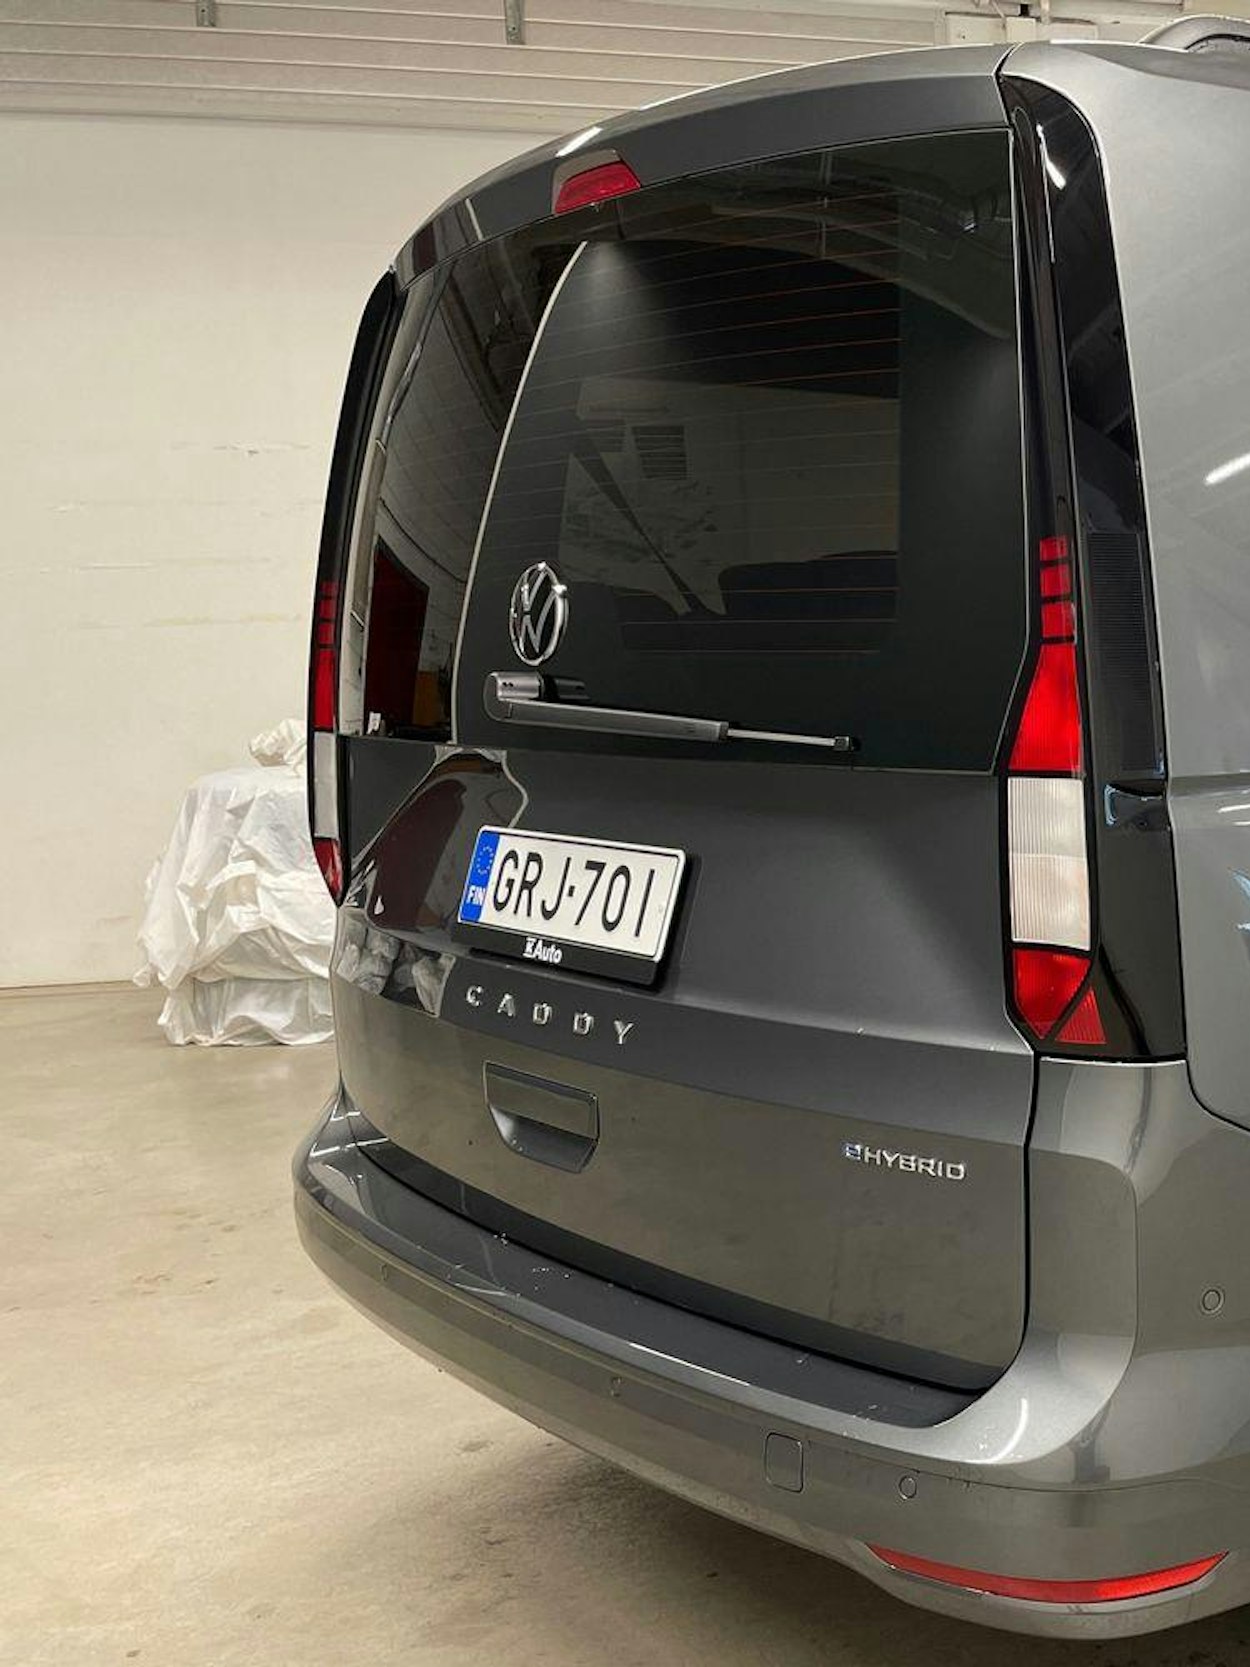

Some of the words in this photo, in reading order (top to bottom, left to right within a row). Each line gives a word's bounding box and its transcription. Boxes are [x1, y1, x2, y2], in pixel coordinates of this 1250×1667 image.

[466, 885, 486, 907] FIN
[493, 848, 656, 938] GRJ-701
[465, 985, 635, 1046] CADDY
